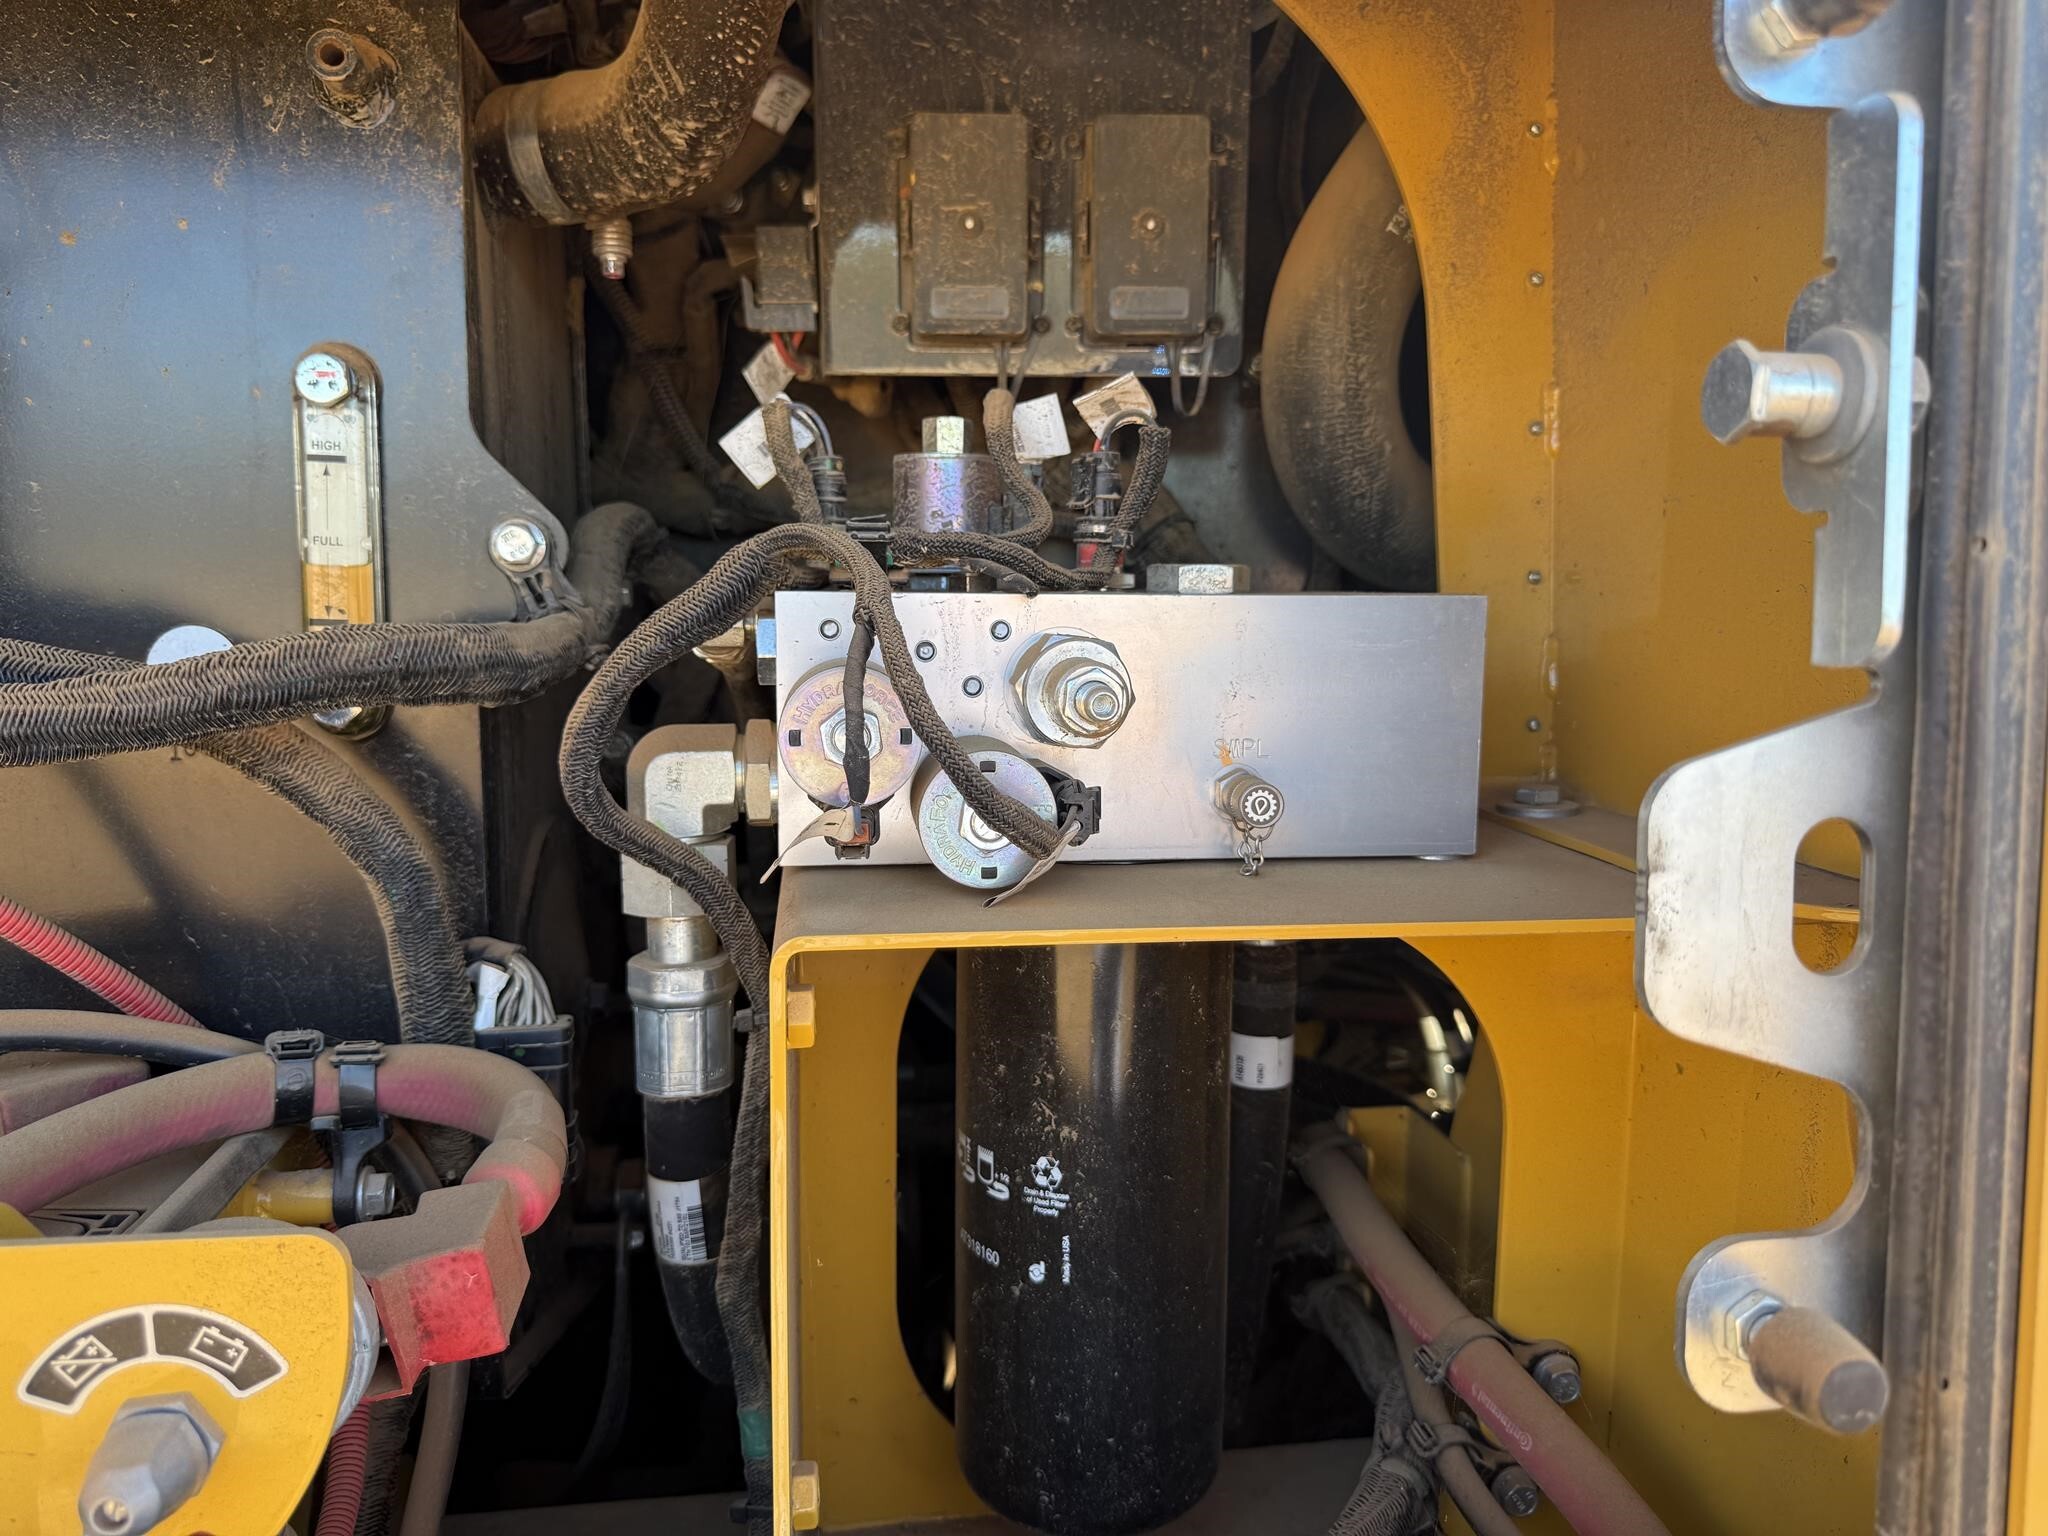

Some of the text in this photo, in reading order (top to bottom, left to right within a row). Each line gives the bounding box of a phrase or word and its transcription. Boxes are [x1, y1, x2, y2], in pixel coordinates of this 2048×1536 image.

[311, 440, 342, 452] HIGH
[312, 535, 344, 547] FULL
[793, 681, 904, 725] HYDRORCE
[1062, 1235, 1071, 1252] USA
